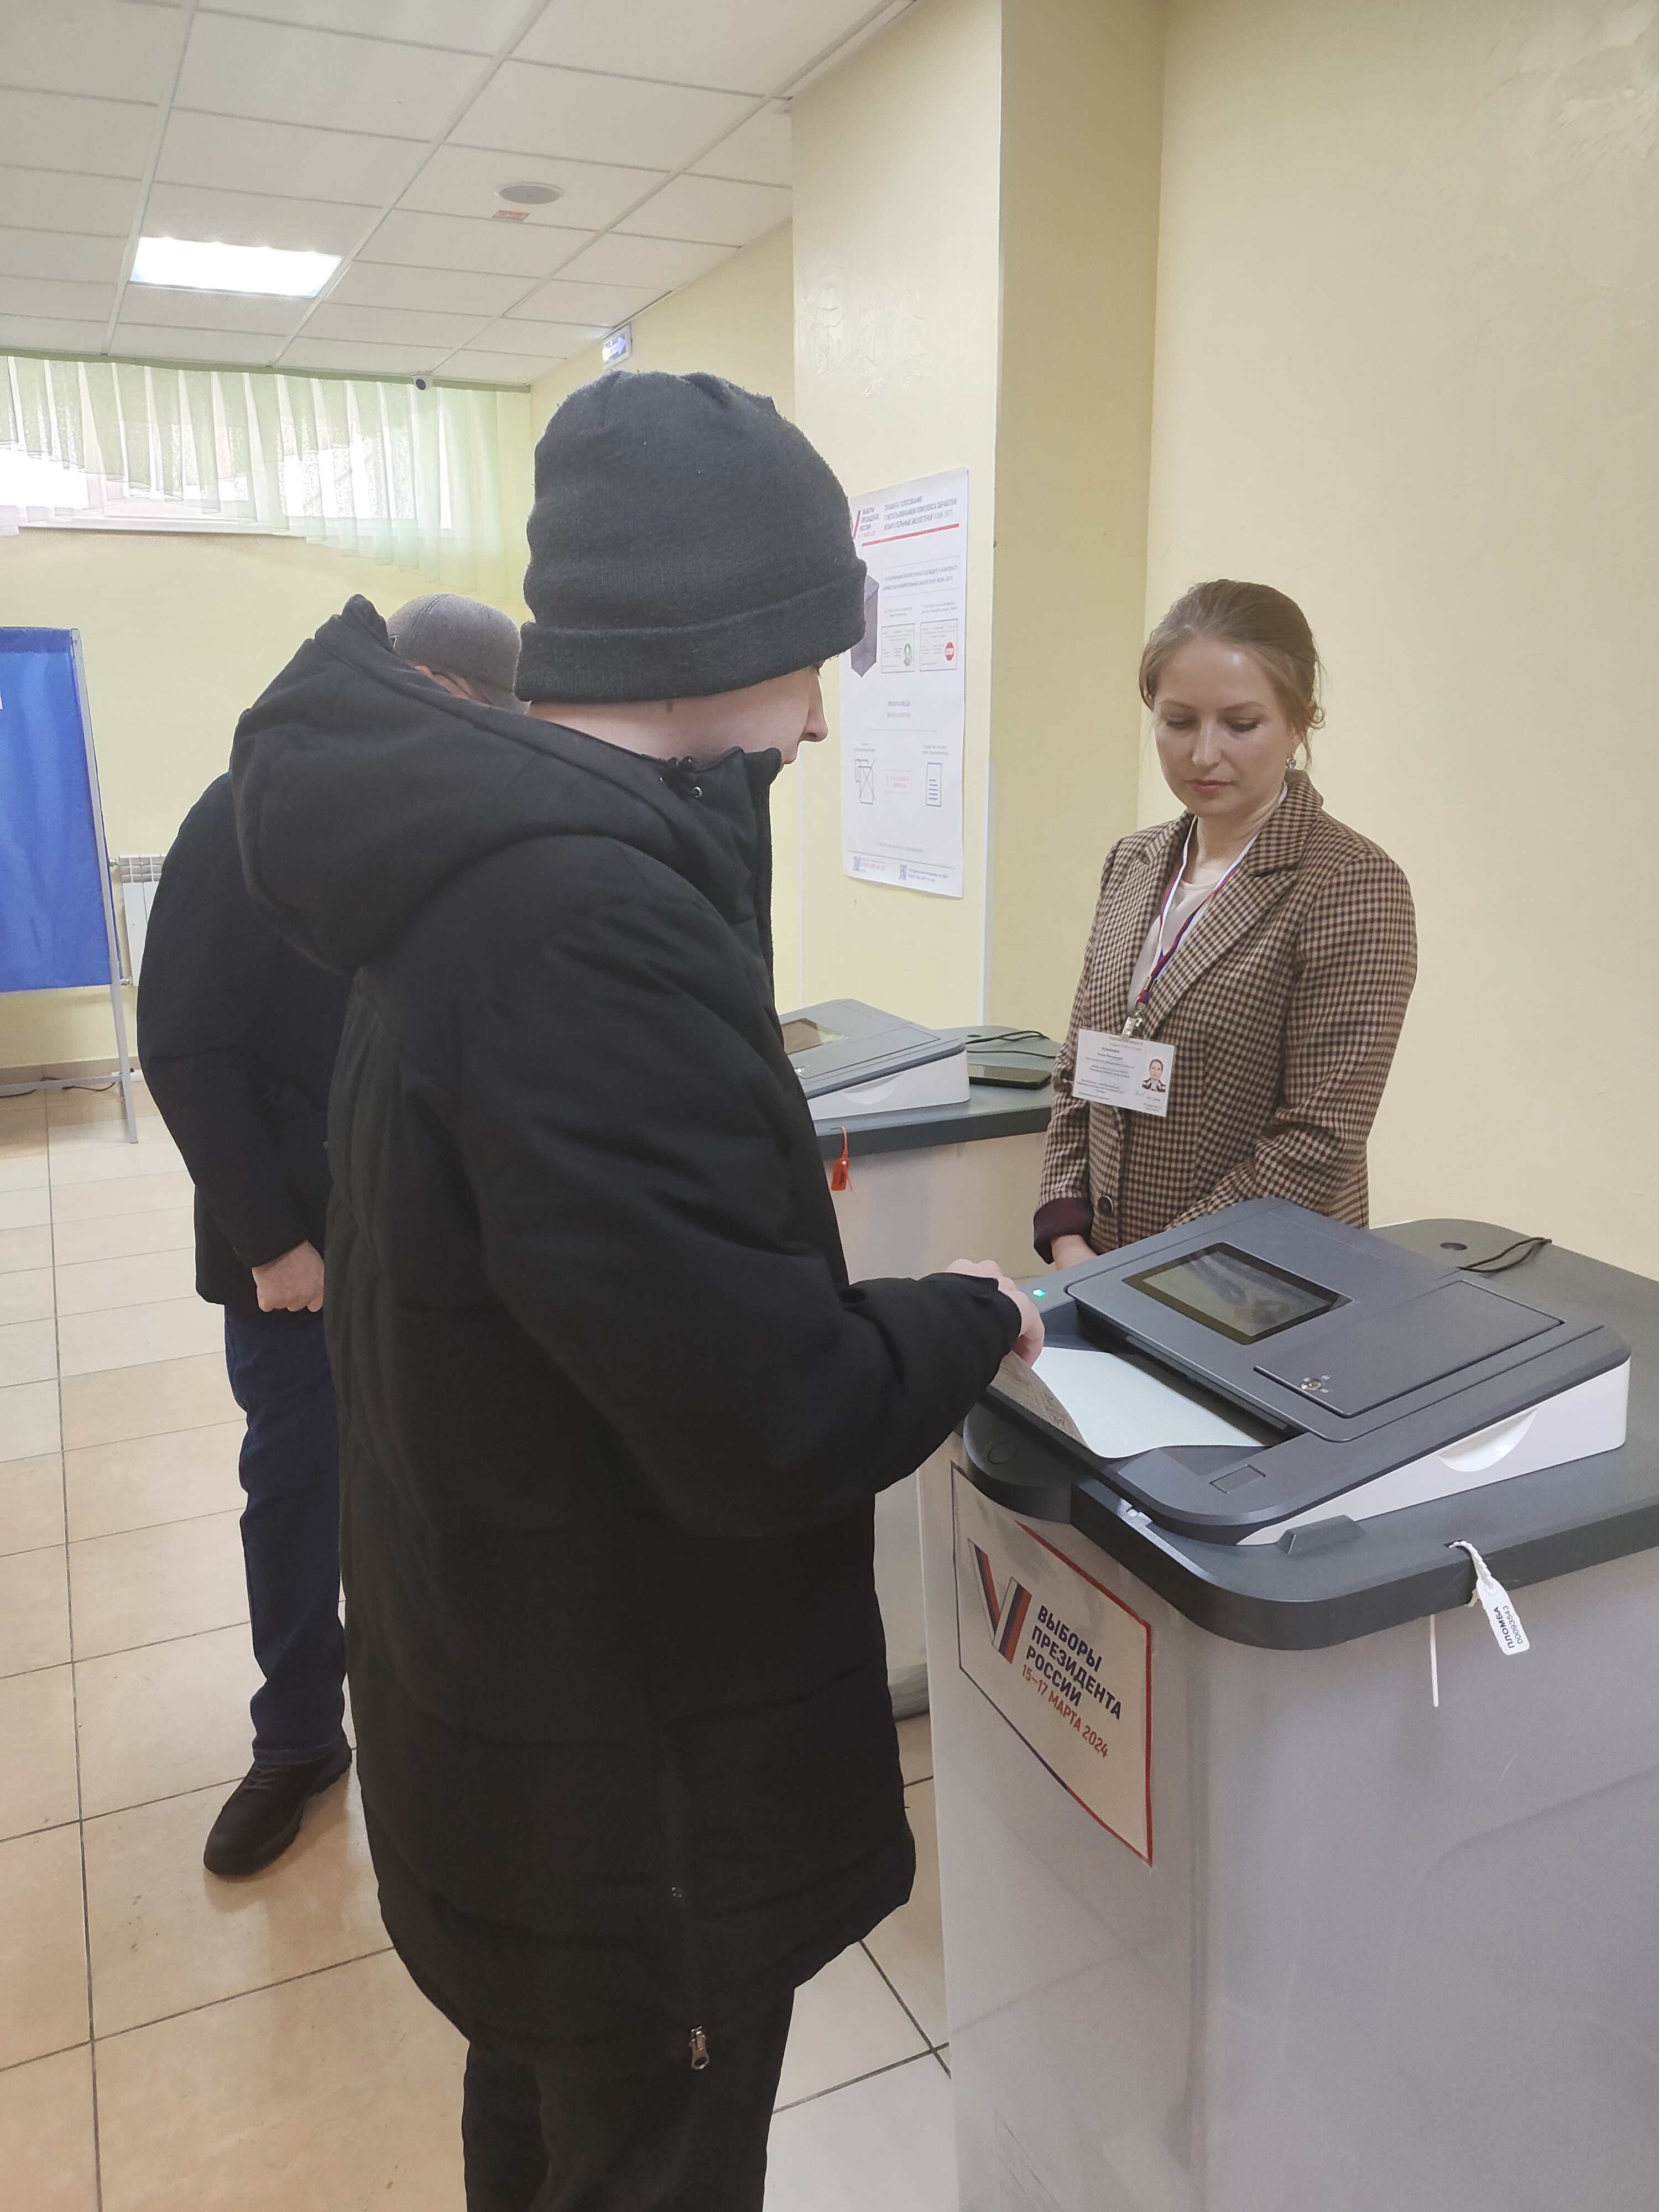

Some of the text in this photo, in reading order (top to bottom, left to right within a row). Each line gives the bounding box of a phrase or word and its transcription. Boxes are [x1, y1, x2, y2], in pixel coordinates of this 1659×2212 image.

[1037, 1605, 1102, 1672] ВЫБОРЫ
[1494, 1606, 1515, 1648] ПЛОМБА
[1026, 1645, 1082, 1707] РОССИИ
[1031, 1625, 1121, 1720] ПРЕЗИДЕНТА
[1048, 1690, 1081, 1731] МАРТА
[1082, 1725, 1108, 1758] 2024
